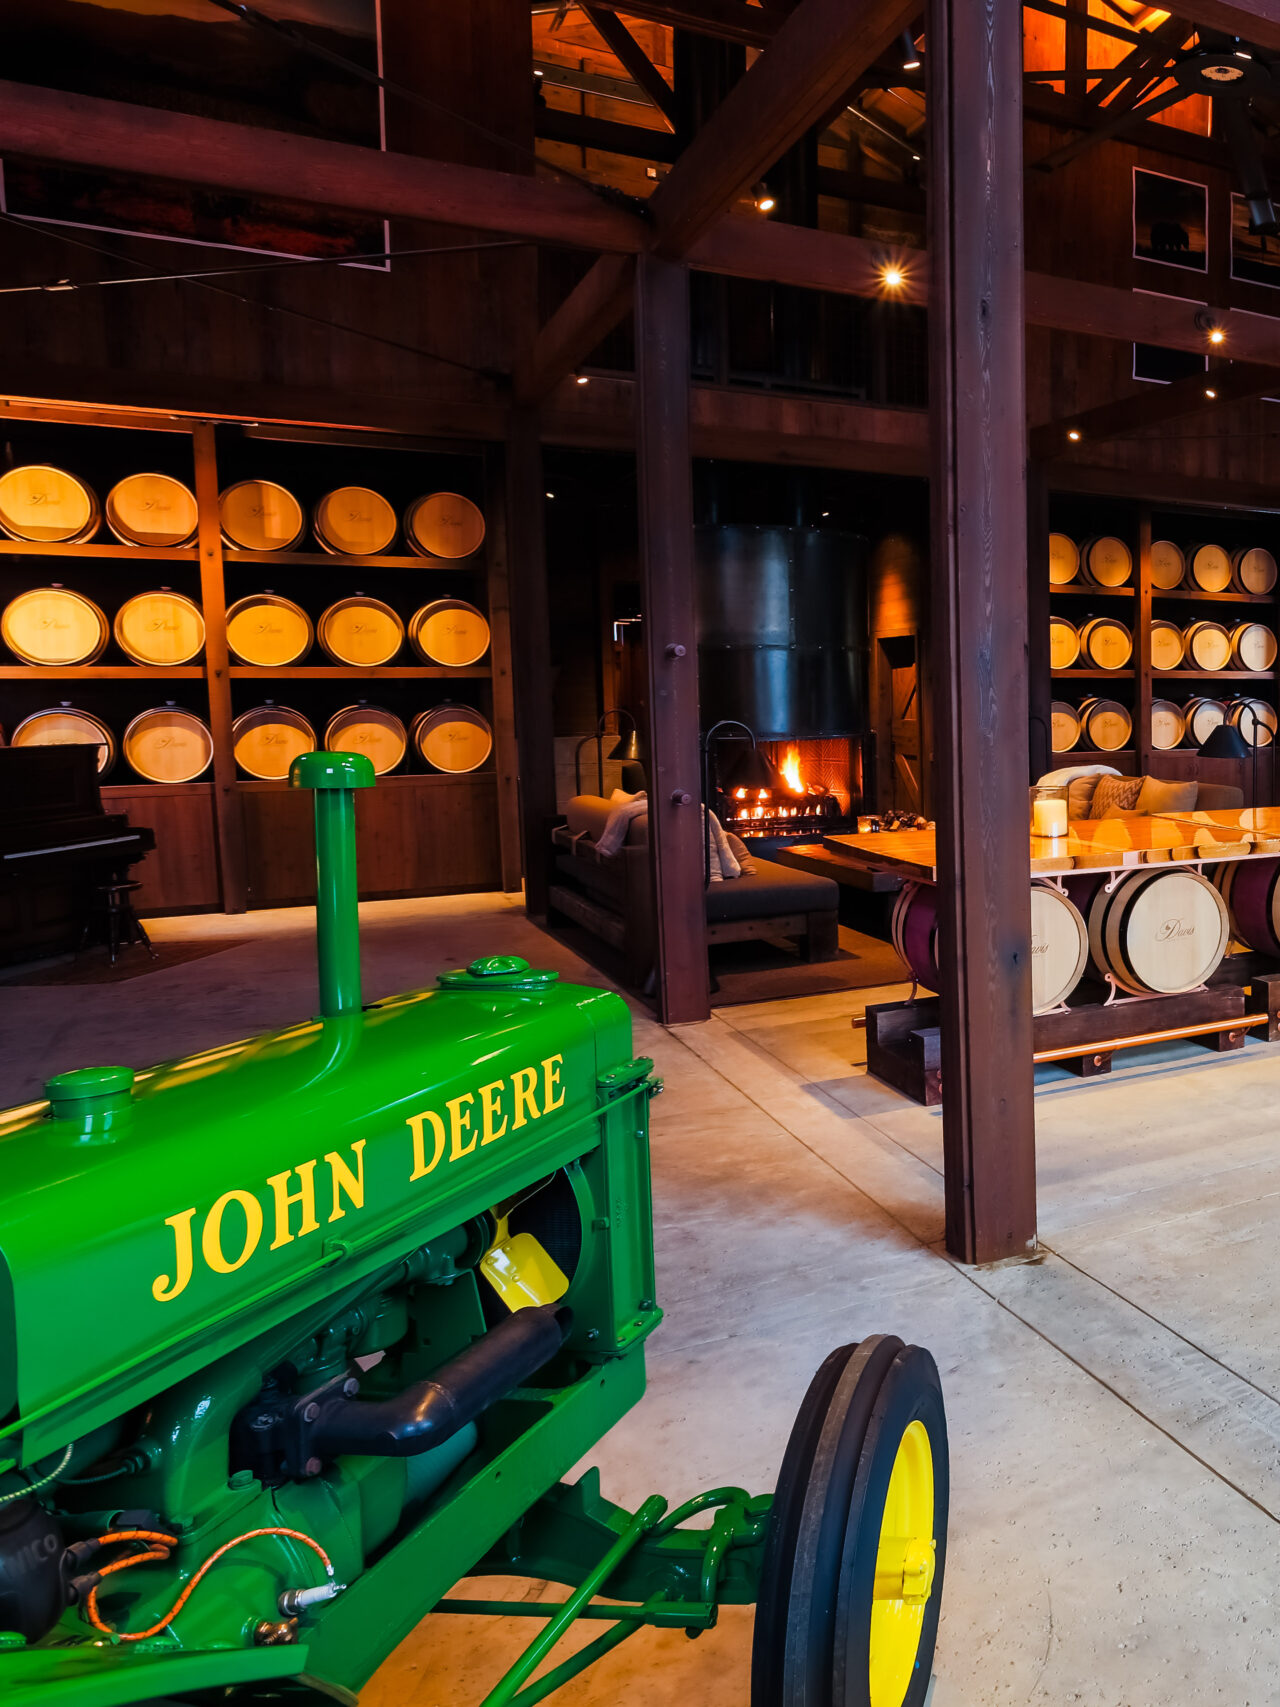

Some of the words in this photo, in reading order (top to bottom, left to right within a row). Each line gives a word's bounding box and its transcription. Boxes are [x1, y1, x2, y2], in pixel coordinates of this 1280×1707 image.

[1154, 918, 1195, 942] Davis
[152, 1138, 367, 1303] JOHN
[405, 1053, 567, 1183] DEERE
